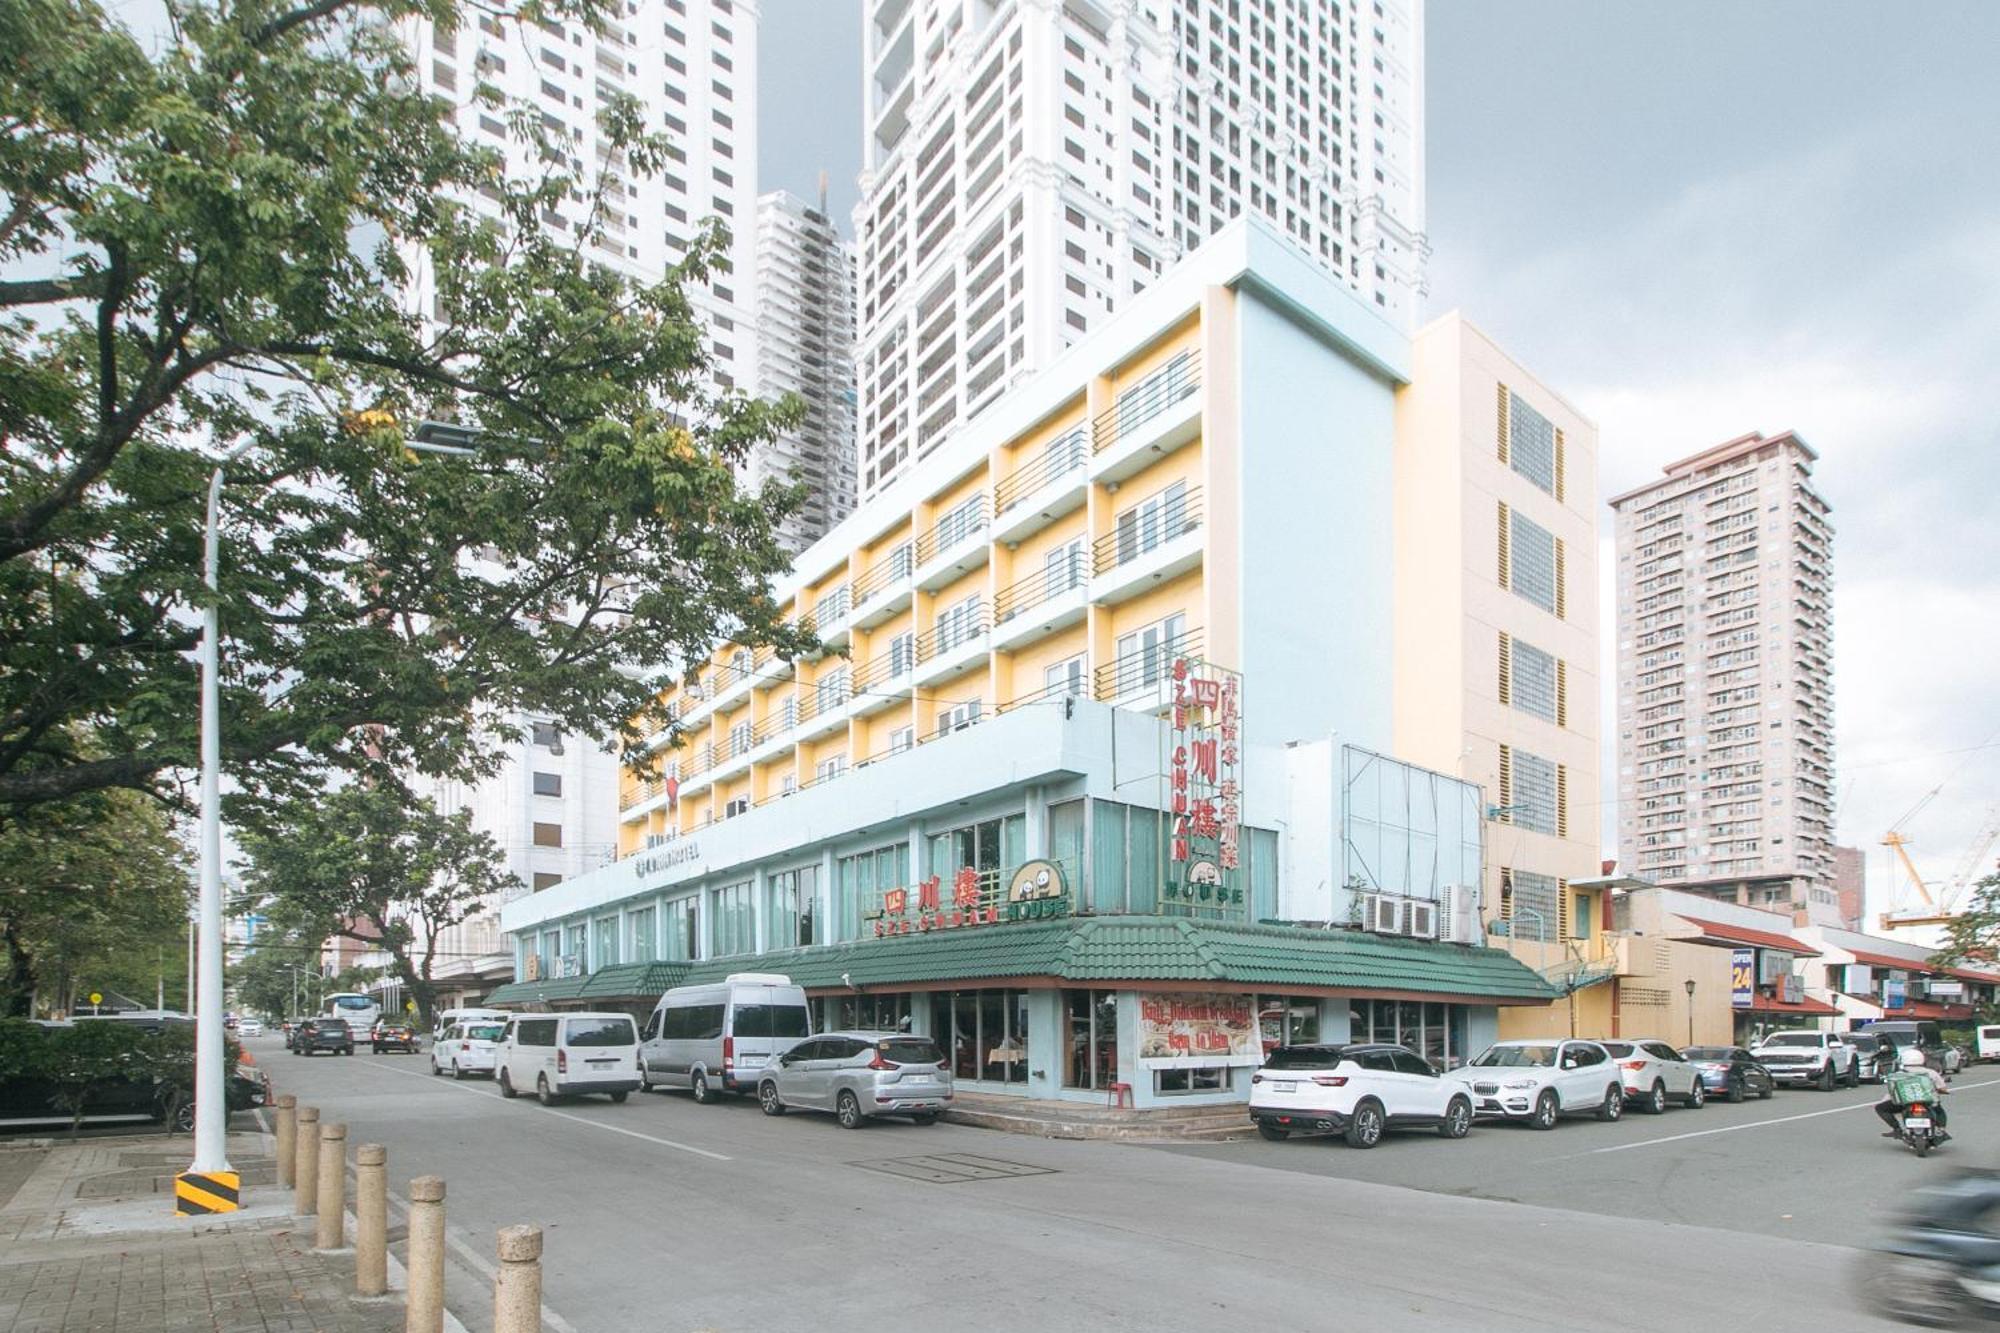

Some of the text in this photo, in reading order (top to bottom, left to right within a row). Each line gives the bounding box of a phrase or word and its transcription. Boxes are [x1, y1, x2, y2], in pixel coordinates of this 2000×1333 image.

[1172, 658, 1189, 861] SZE CHUAN
[1190, 678, 1220, 840] 四川樓
[1166, 881, 1243, 904] HOUSE
[1008, 897, 1068, 921] HOUSE
[1733, 967, 1750, 989] 24
